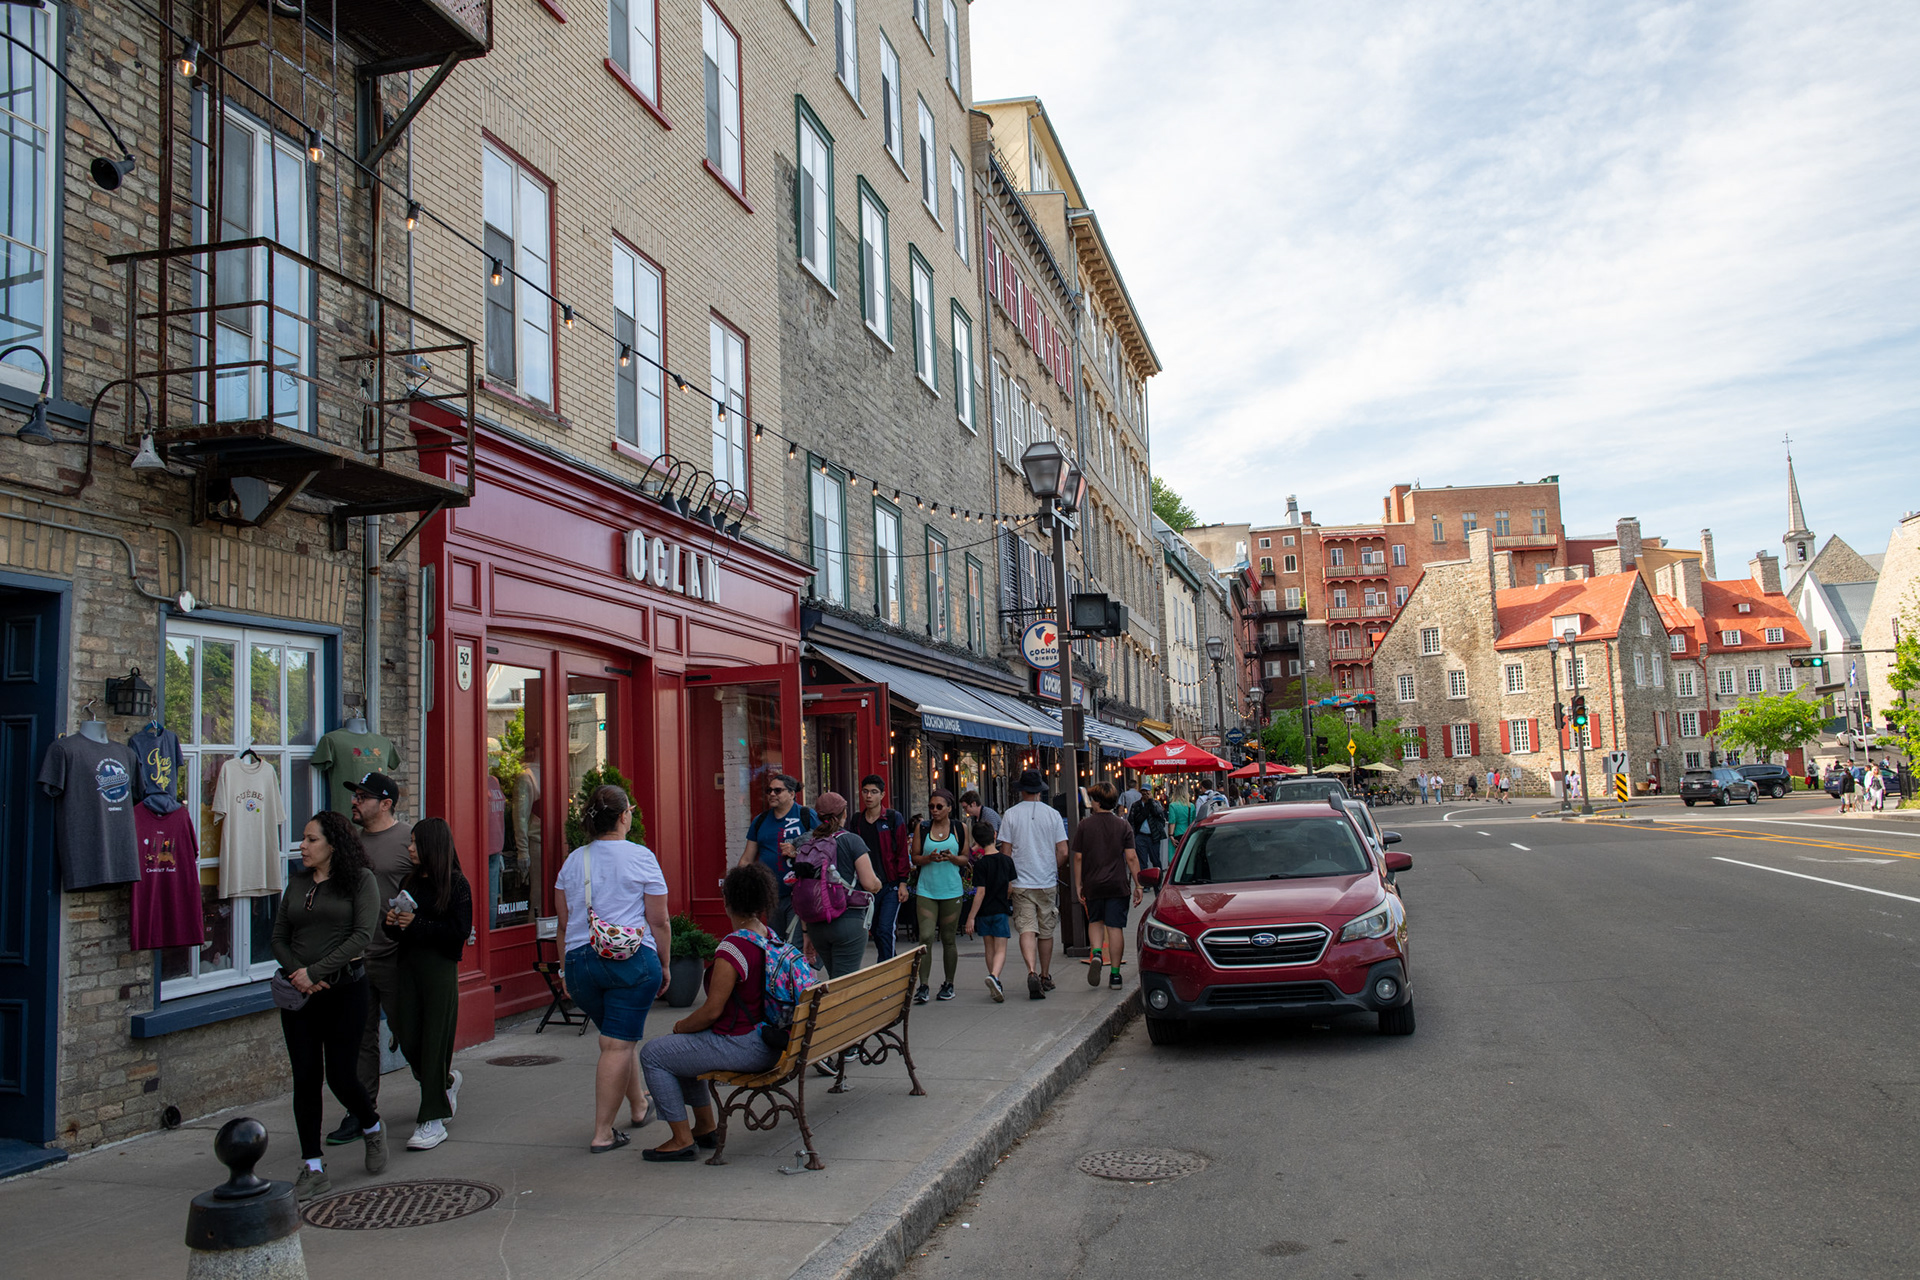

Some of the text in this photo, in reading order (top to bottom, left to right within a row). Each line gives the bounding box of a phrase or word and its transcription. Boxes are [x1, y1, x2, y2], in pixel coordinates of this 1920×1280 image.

[627, 529, 720, 604] OCLAN
[460, 652, 470, 665] 52
[924, 714, 961, 732] COCHON DINGUE
[235, 789, 264, 804] QUÉBE
[498, 903, 510, 914] FUCK
[510, 902, 516, 912] LA
